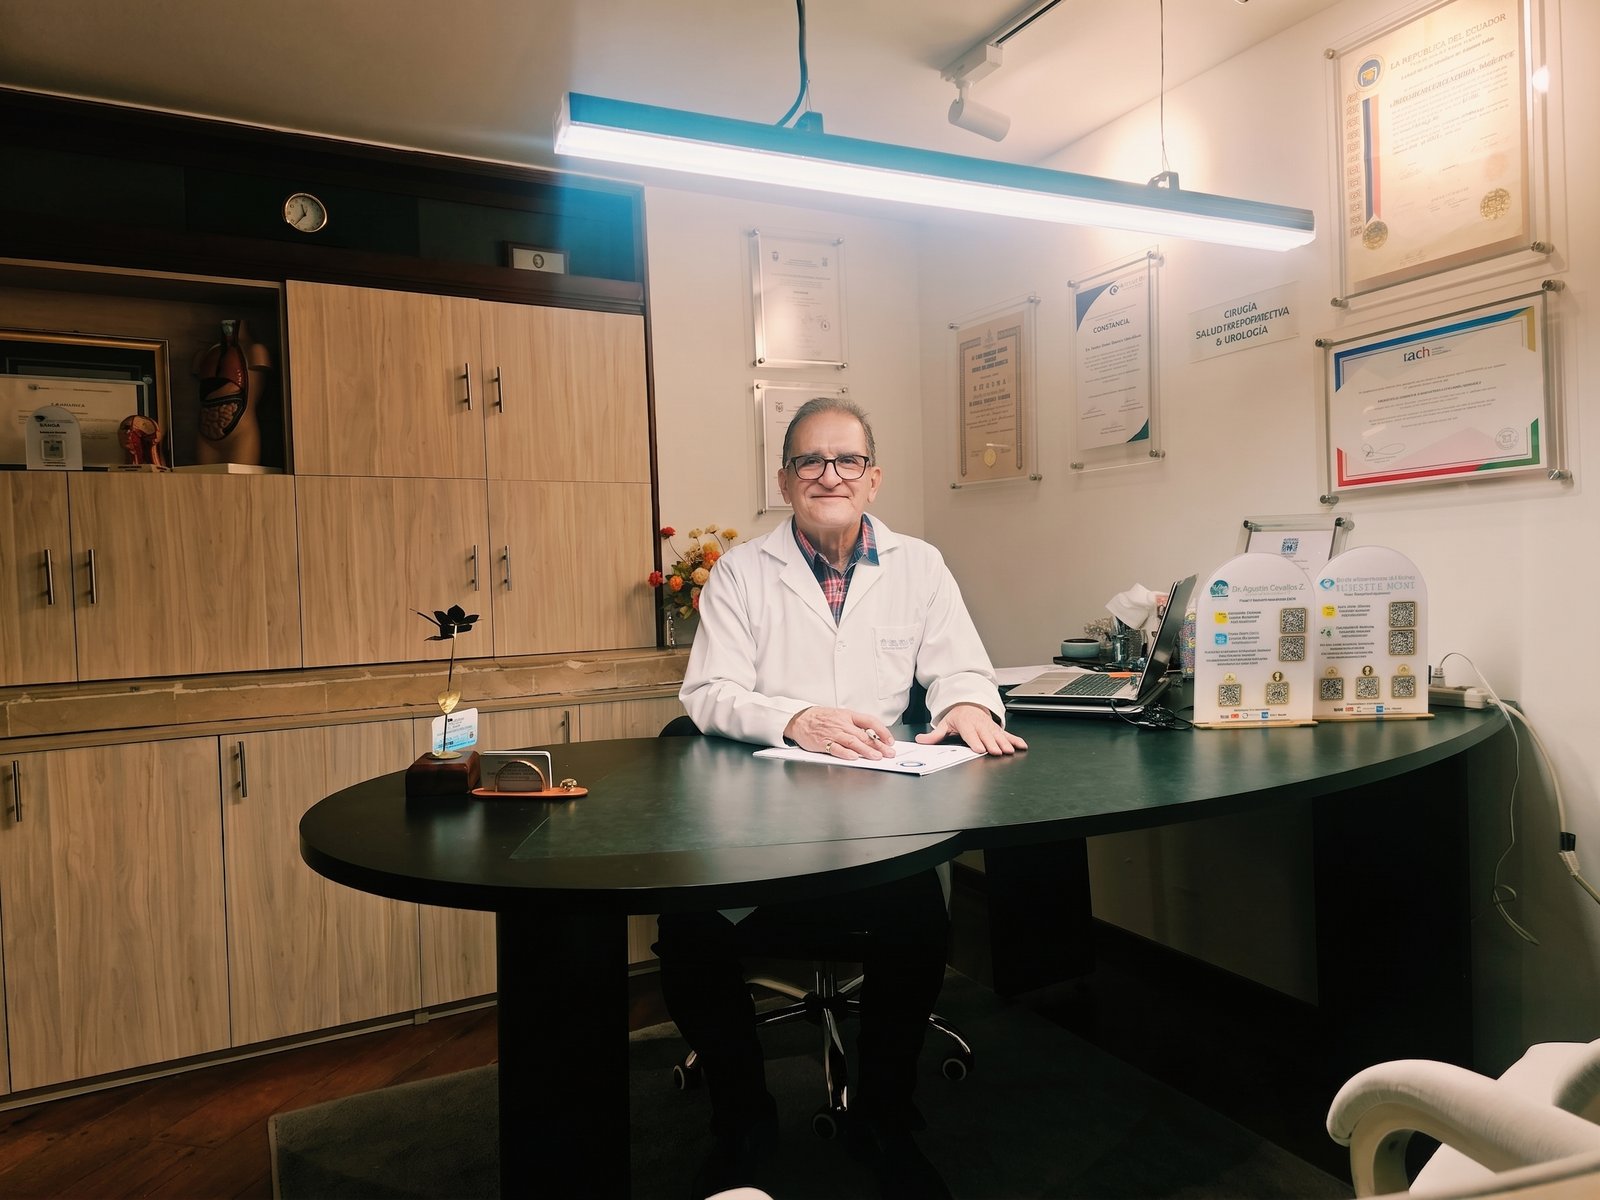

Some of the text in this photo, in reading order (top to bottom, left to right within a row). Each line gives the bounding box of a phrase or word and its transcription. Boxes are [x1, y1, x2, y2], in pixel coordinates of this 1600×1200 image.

[1465, 13, 1507, 37] ECUADOR
[1224, 302, 1257, 319] CIRUGÍA
[1093, 318, 1130, 334] CONSTANCIA
[1216, 337, 1222, 346] &
